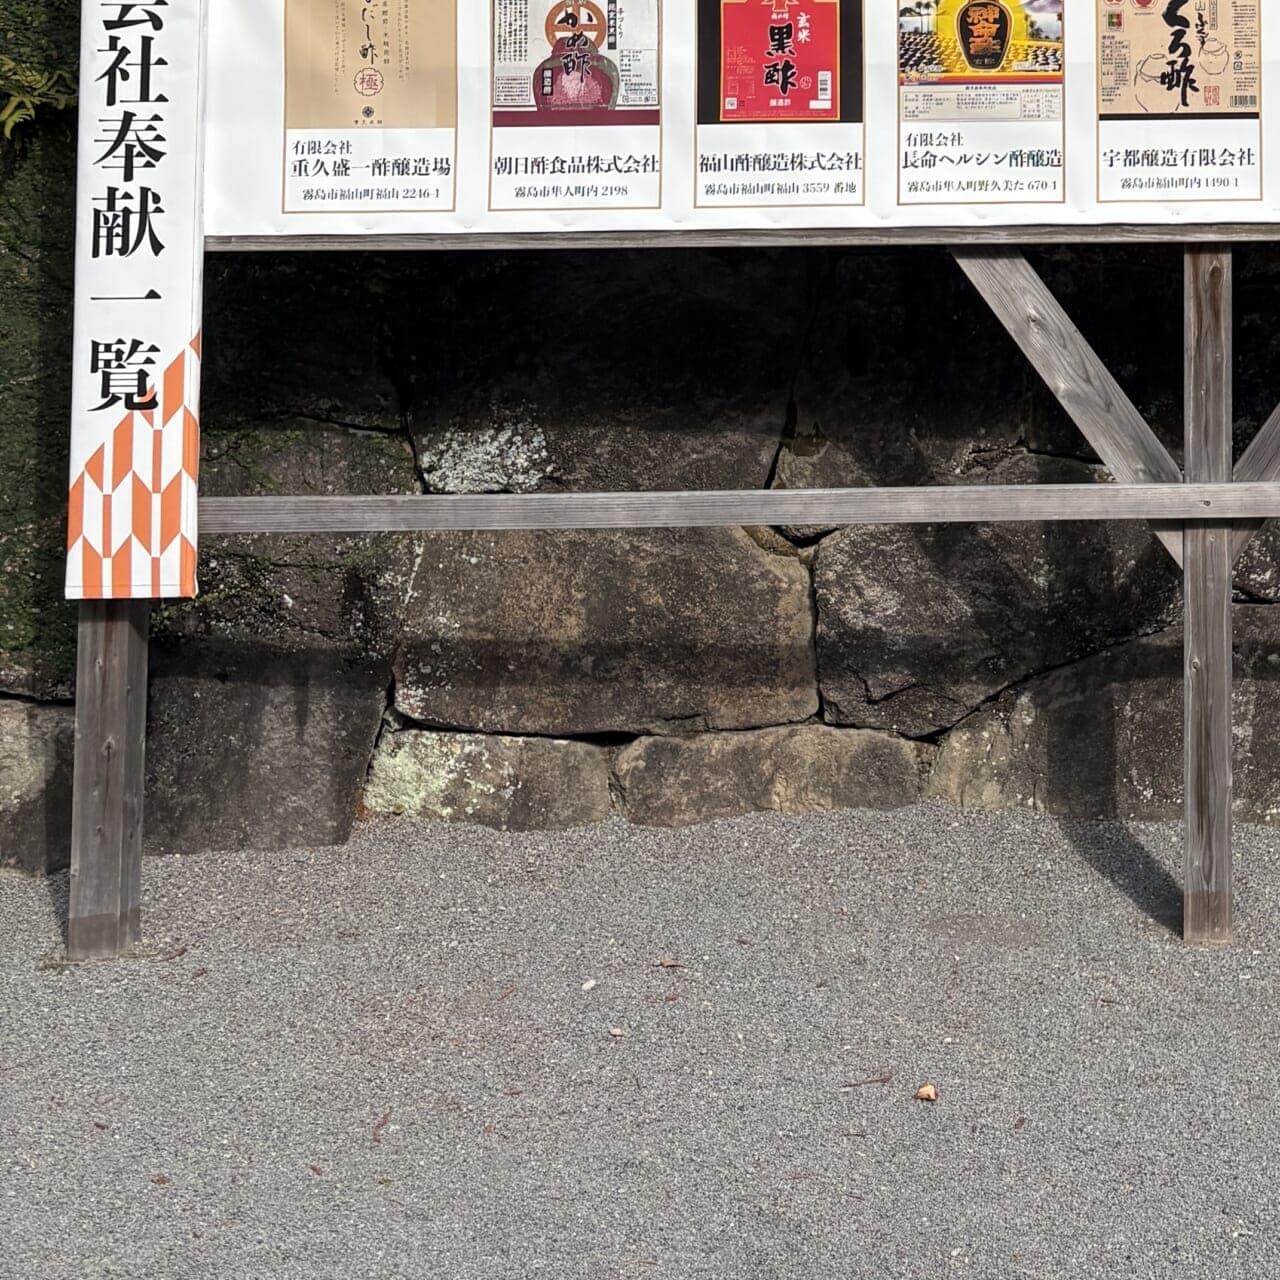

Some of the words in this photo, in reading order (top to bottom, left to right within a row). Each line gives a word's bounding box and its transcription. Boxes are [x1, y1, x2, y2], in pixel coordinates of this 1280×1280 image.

[764, 22, 799, 97] 黒酢
[293, 140, 352, 155] 有限会社
[906, 132, 963, 147] 有限会社
[291, 157, 451, 177] 重久盛一酢醸造場
[494, 155, 660, 175] 朝日酢食品株式会社
[699, 152, 863, 172] 福山酢醸造株式会社
[902, 149, 1064, 169] 長命ヘルシン酢醸造
[1103, 148, 1255, 167] 宇都醸造有限会社
